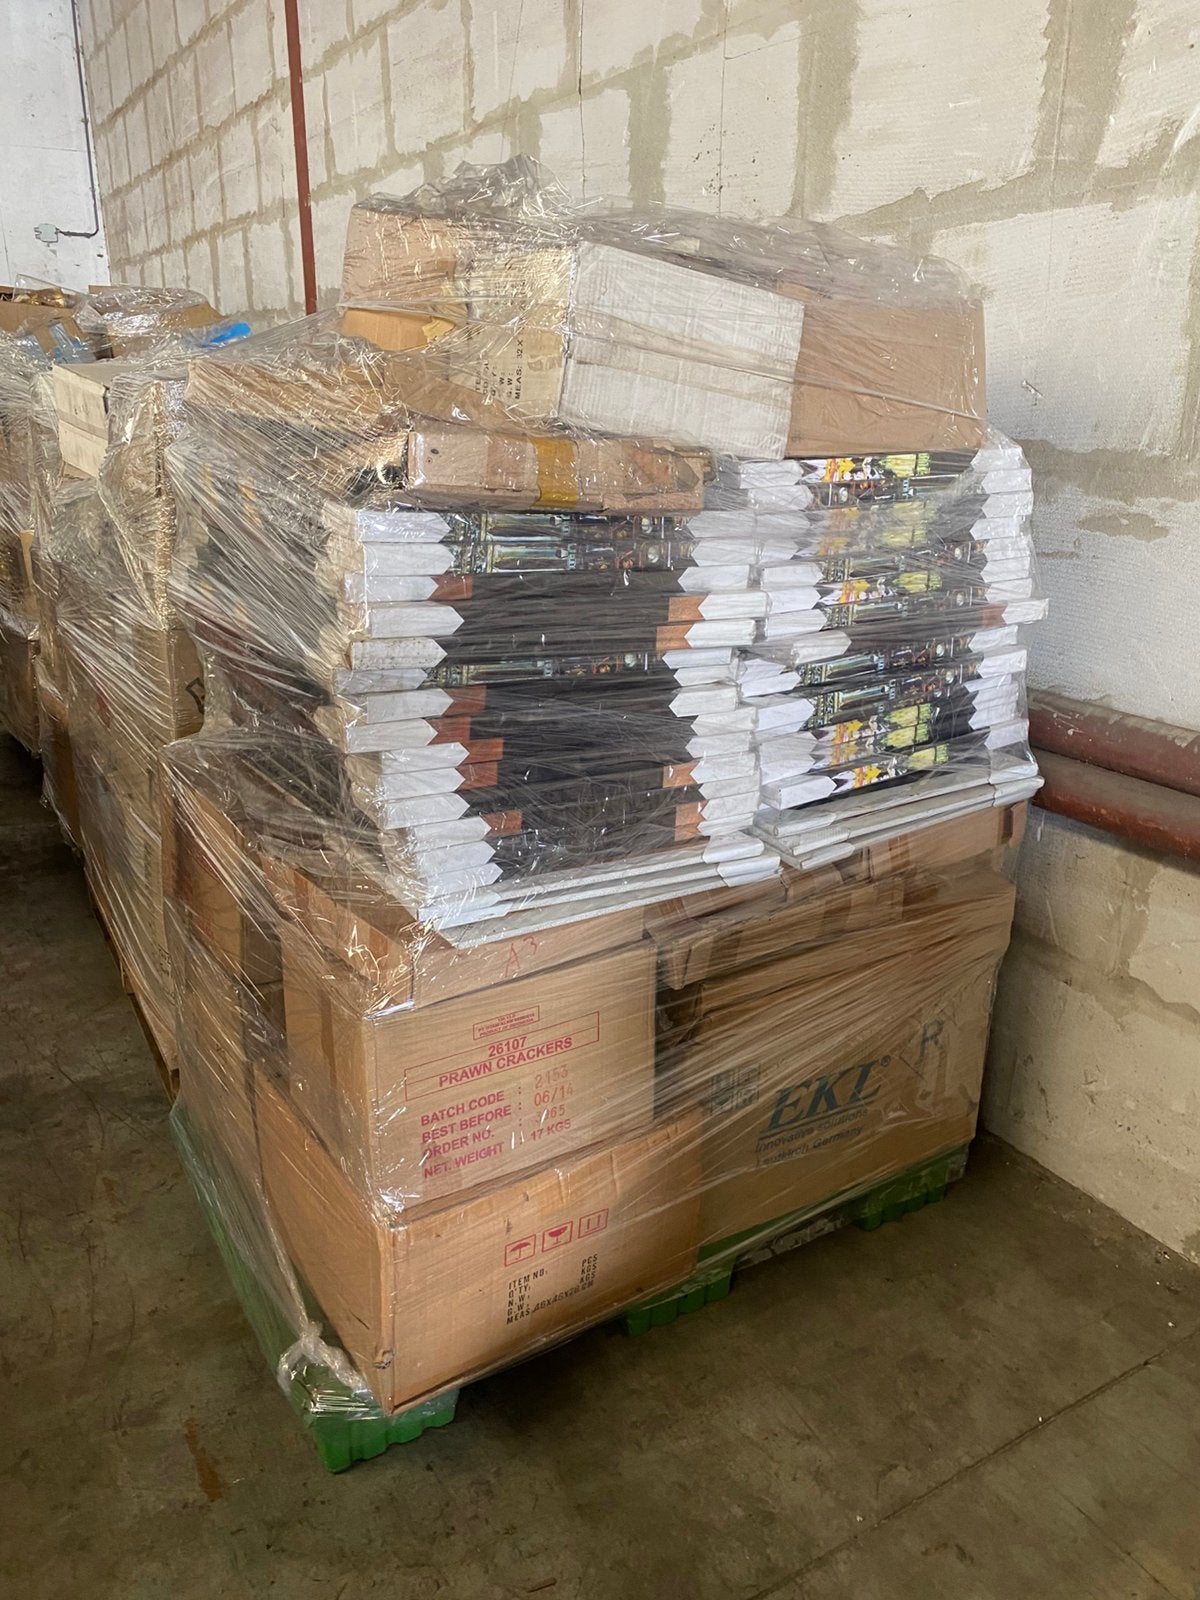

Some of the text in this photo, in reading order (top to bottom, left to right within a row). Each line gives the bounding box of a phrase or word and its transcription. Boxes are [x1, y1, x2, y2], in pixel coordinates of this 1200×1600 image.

[438, 1037, 573, 1088] PRAWN CRACKERS
[488, 1036, 528, 1058] 26107
[420, 1105, 465, 1127] BATCH
[468, 1090, 505, 1111] CODE
[421, 1123, 456, 1144] BEST
[459, 1105, 512, 1131] BEFORE
[422, 1137, 470, 1160] ORDER
[472, 1127, 496, 1146] NO.
[423, 1118, 572, 1179] NET. WEIGHT 17 KGS
[581, 1253, 598, 1267] PCS
[508, 1274, 530, 1290] ITEM
